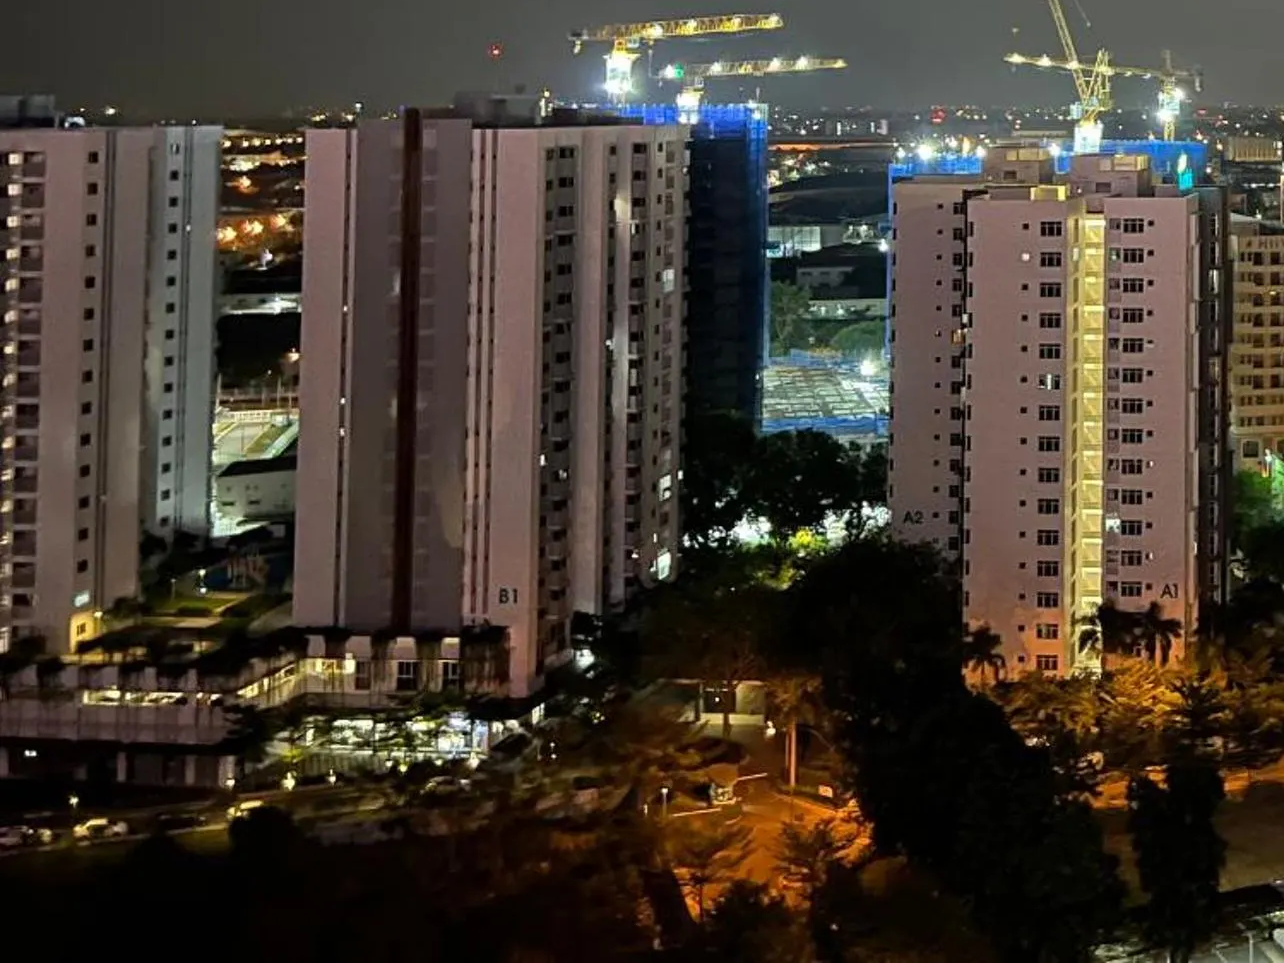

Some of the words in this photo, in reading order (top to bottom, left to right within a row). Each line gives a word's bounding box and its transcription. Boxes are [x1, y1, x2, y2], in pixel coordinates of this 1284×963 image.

[903, 510, 924, 524] A2
[499, 587, 518, 604] B1
[1160, 583, 1178, 598] A1
